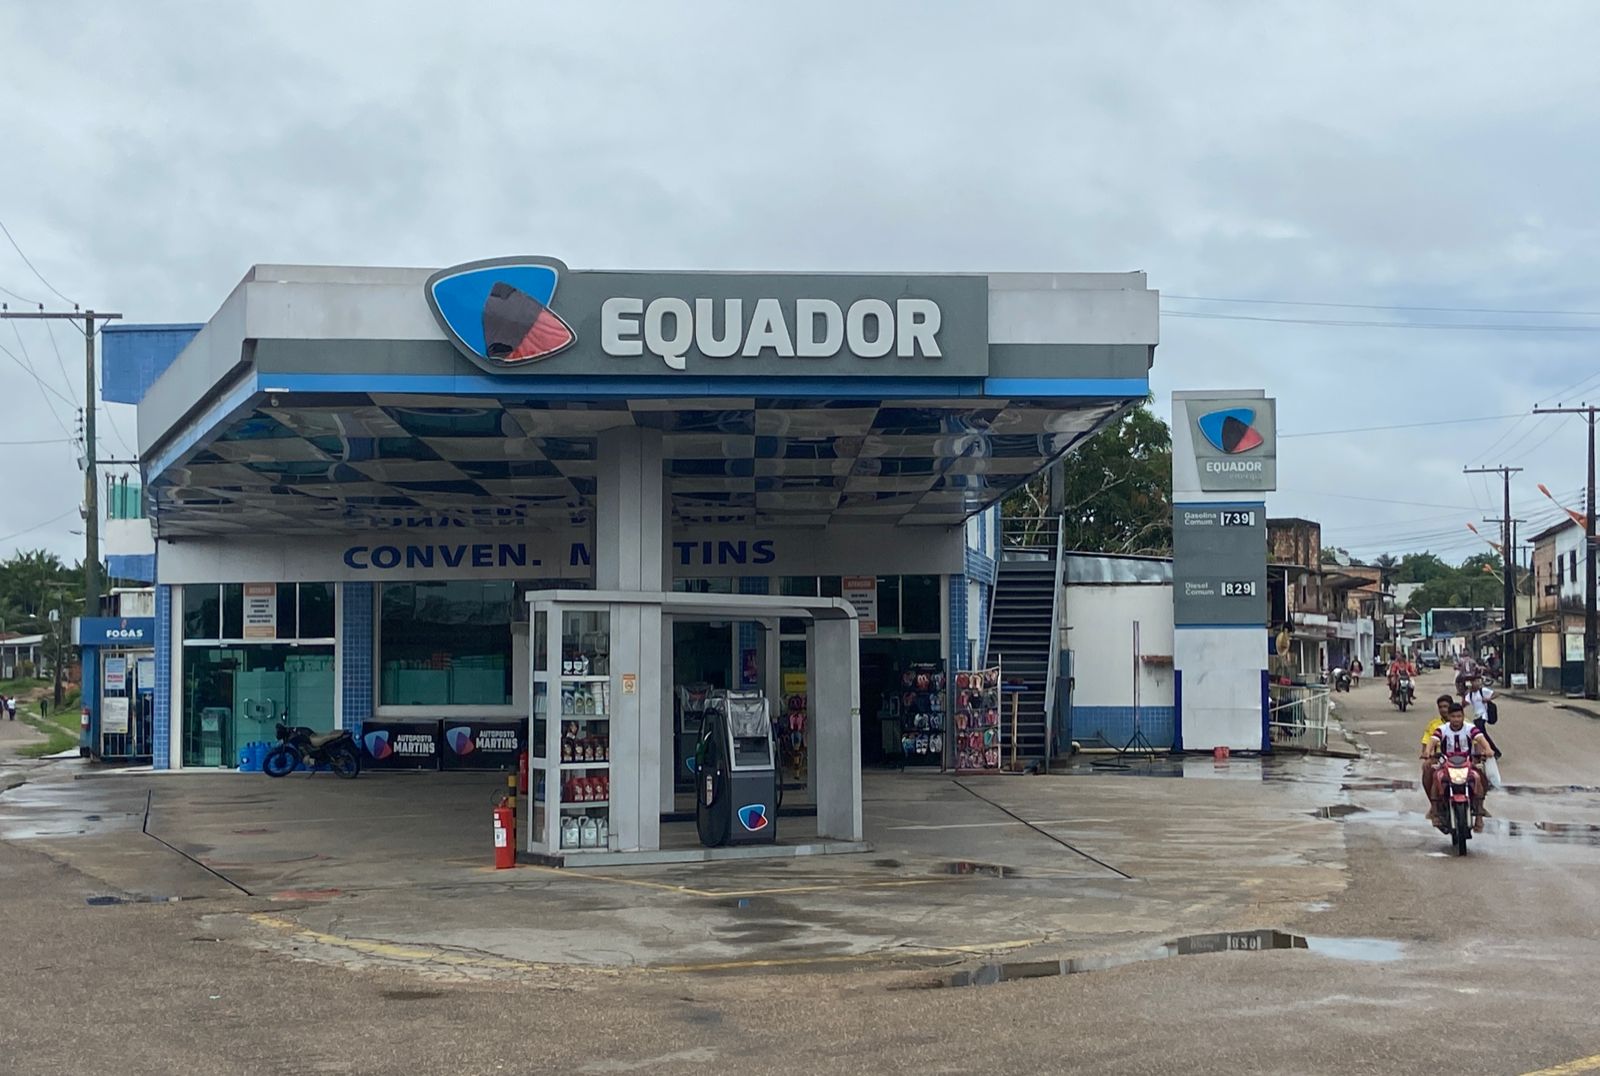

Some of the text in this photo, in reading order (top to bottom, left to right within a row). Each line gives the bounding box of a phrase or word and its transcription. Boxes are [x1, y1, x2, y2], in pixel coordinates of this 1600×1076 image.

[601, 297, 942, 370] EQUADOR
[1206, 462, 1262, 474] EQUADOR
[343, 540, 776, 569] CONVEN. MTINS
[106, 629, 143, 638] FOGAS
[397, 734, 432, 742] AUTOPOSTO
[479, 730, 515, 738] AUTOPOSTO
[393, 742, 435, 754] MARTINS
[476, 738, 518, 749] MARTINS
